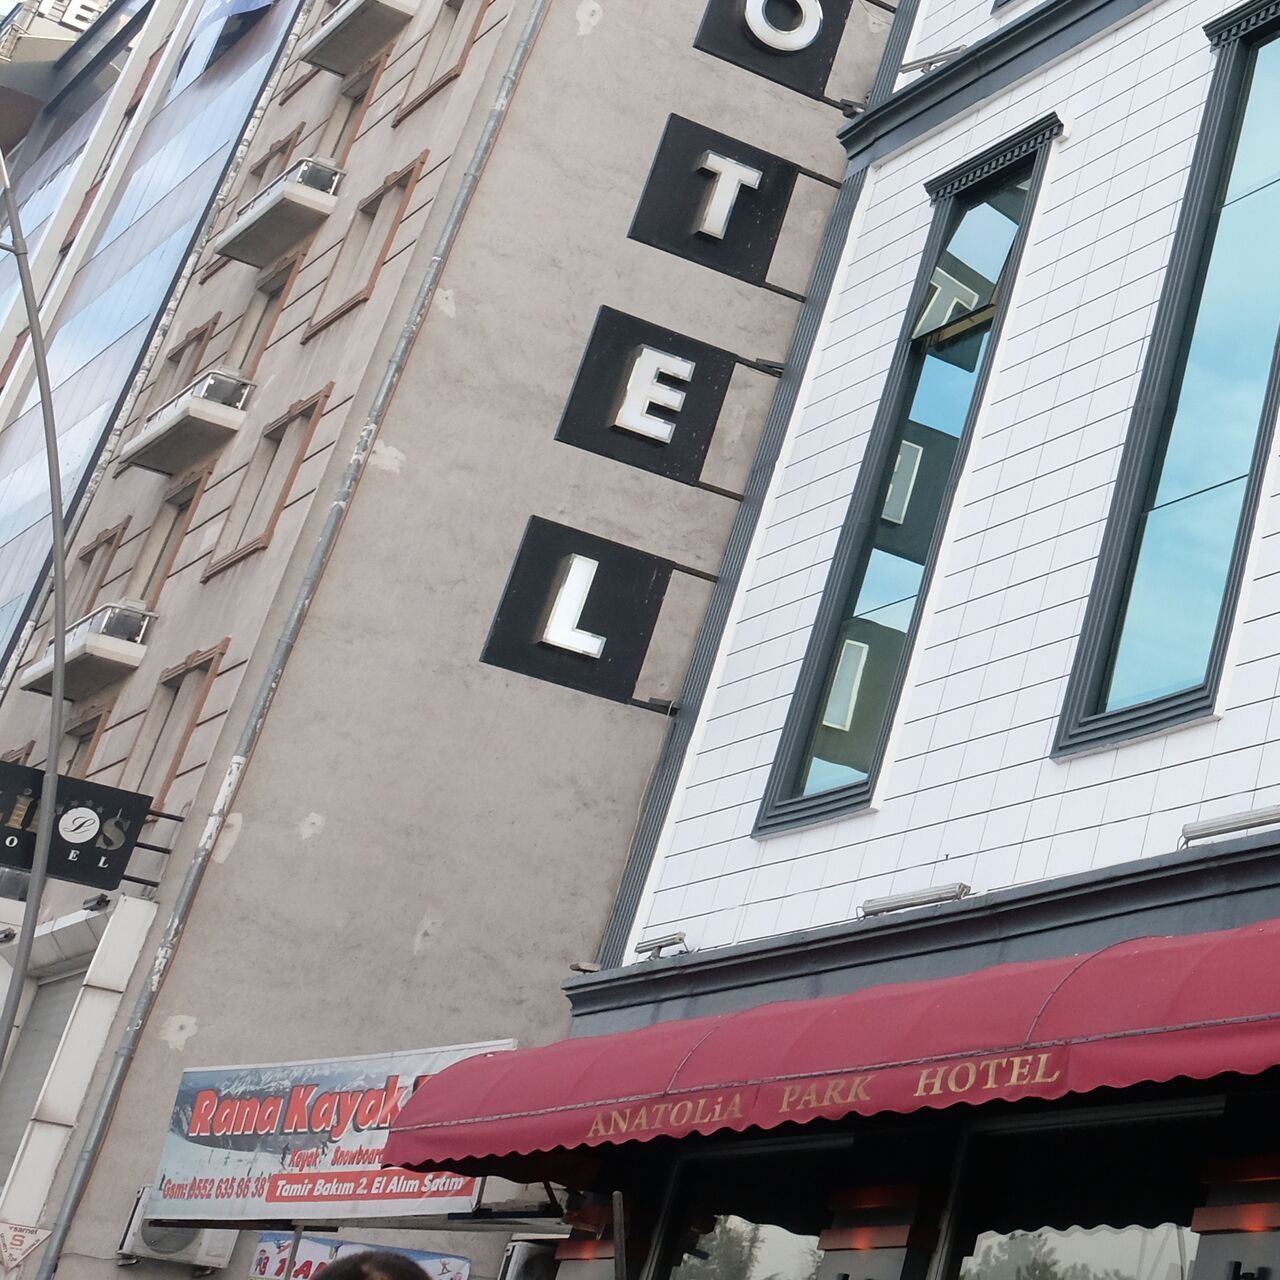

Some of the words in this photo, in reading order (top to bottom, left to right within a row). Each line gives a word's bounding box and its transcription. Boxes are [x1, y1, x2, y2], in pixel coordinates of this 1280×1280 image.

[188, 1088, 284, 1138] Rana
[284, 1075, 402, 1142] Kayak
[778, 1075, 877, 1113] PARK
[913, 1053, 1061, 1097] HOTEL
[276, 1179, 313, 1197] Tamir
[371, 1177, 384, 1194] El
